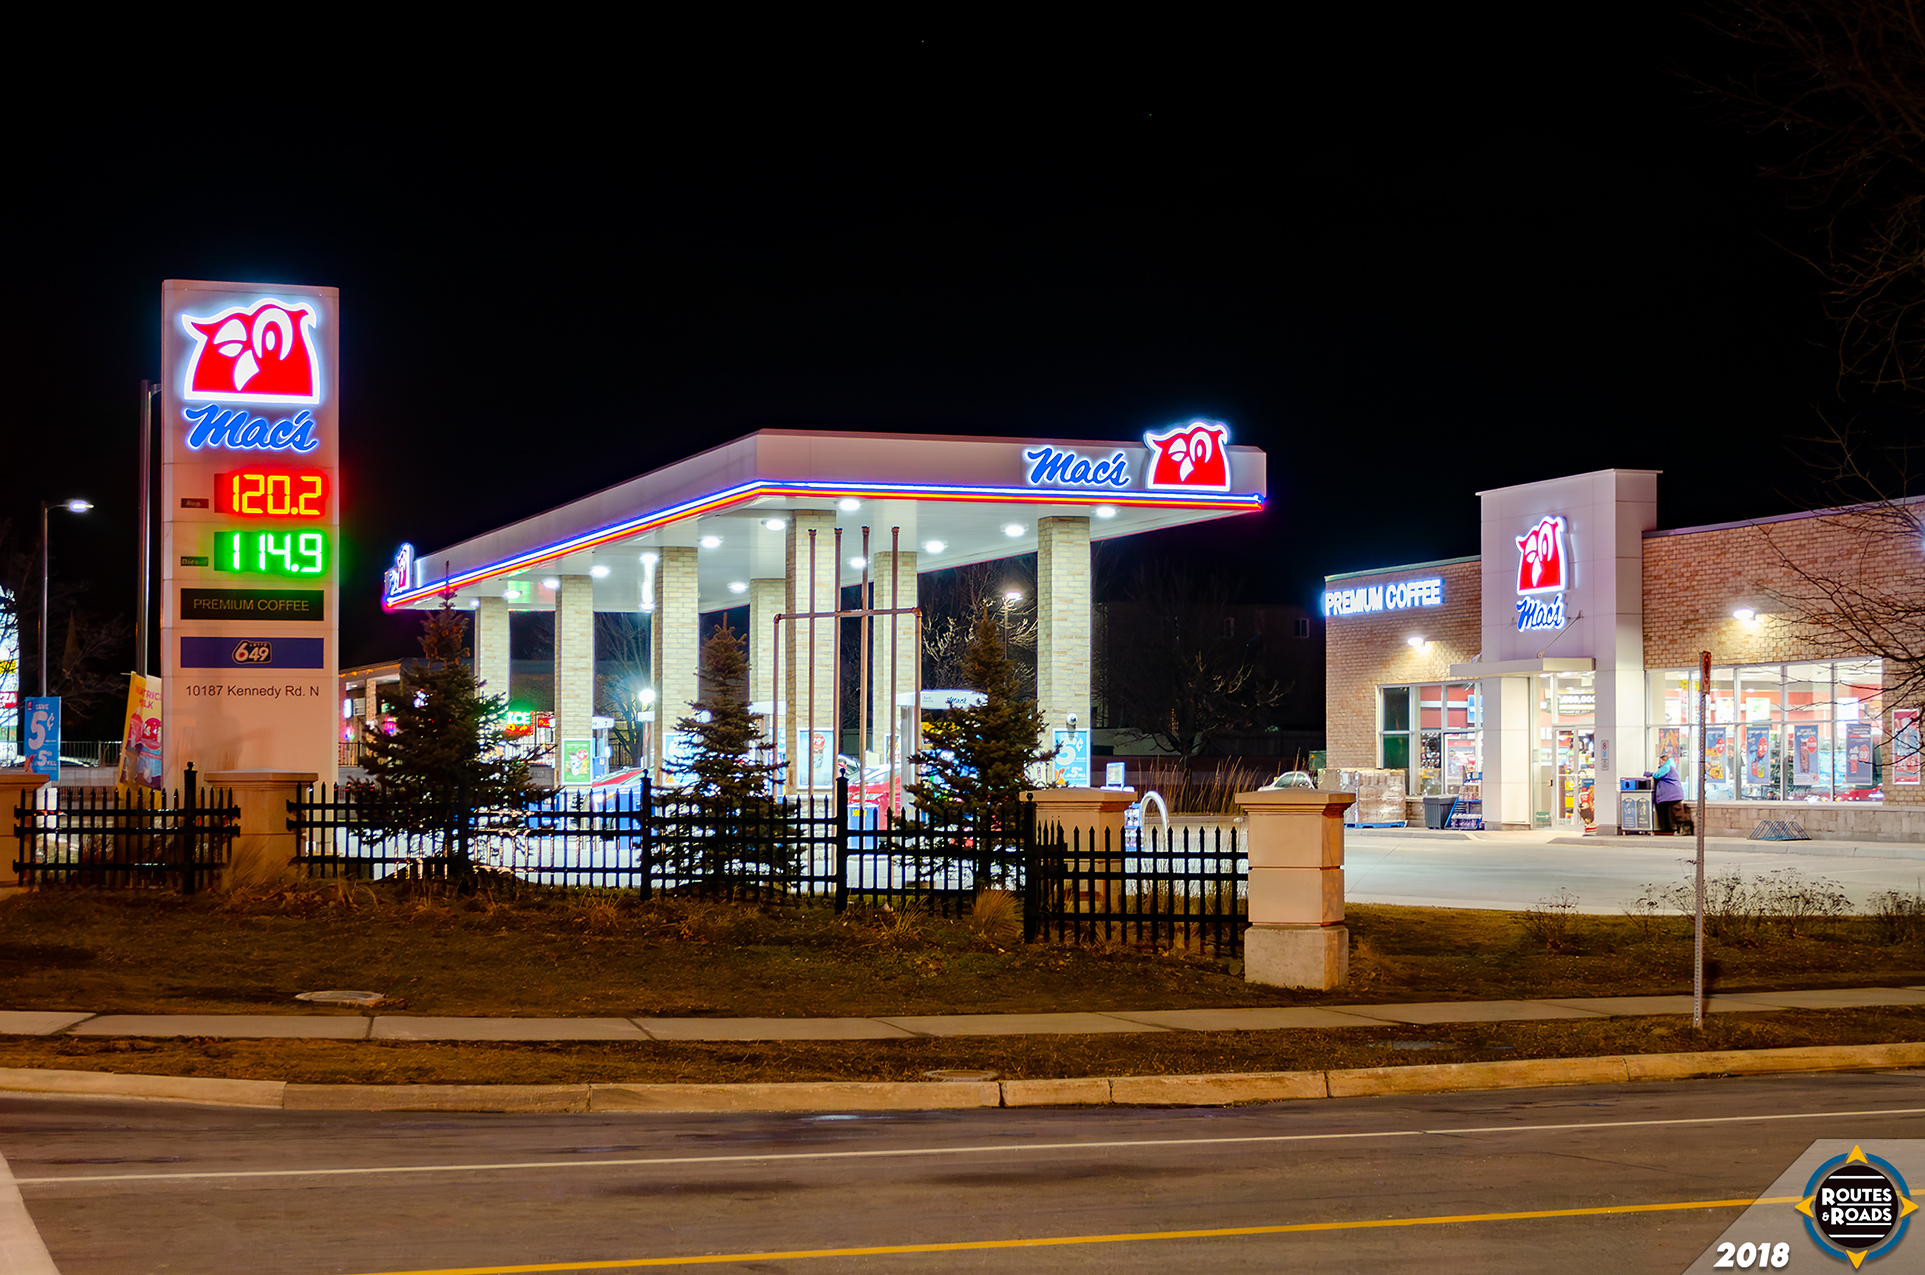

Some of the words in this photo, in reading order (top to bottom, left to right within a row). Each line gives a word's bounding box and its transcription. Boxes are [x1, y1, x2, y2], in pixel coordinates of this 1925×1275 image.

[184, 404, 319, 452] Mac's
[1026, 447, 1130, 487] Mac's
[233, 474, 321, 515] 120.2
[233, 533, 322, 572] 114.9
[193, 598, 254, 610] PREMIUM
[257, 600, 309, 611] COFFEE
[1325, 587, 1383, 616] PREMIUM
[1386, 580, 1441, 610] COFFEE
[1516, 594, 1564, 632] Mac's
[186, 686, 223, 696] 10187
[227, 685, 281, 698] Kennedy
[285, 686, 305, 697] Rd.
[310, 686, 319, 696] N
